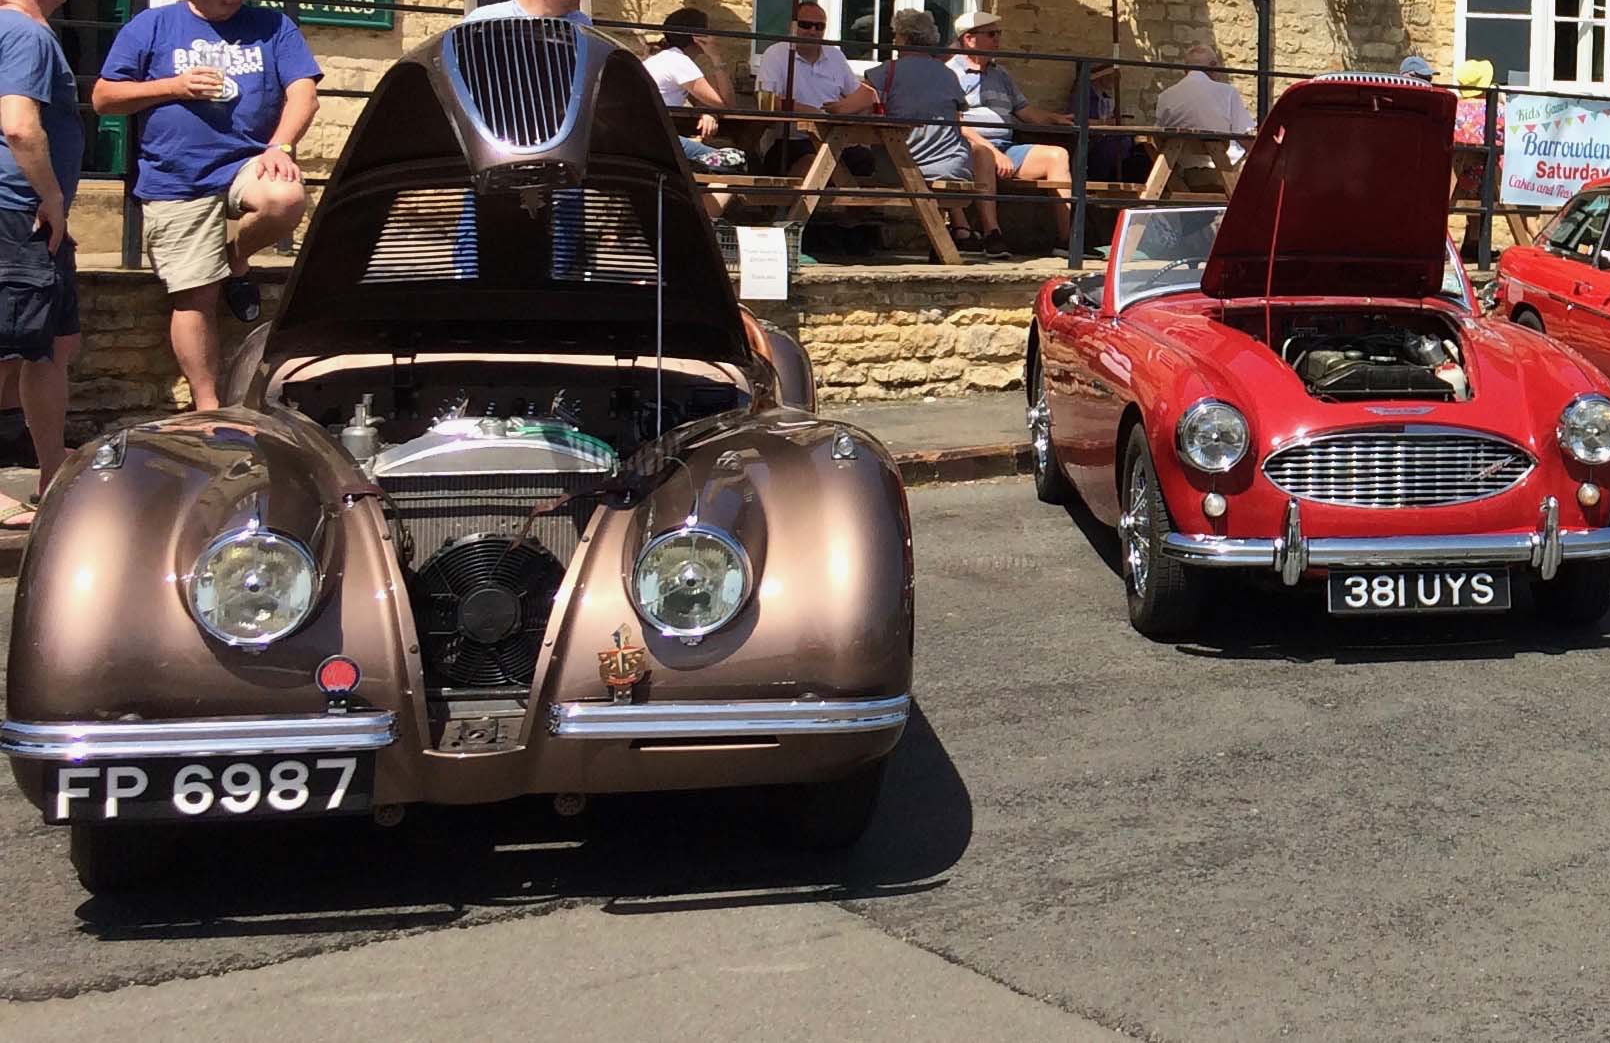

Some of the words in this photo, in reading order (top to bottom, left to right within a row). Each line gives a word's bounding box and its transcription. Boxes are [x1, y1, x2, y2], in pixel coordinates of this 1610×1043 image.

[1522, 132, 1610, 159] Barrowden
[1536, 160, 1609, 181] Saturday
[1509, 174, 1535, 193] Cakes
[1536, 182, 1553, 196] and
[1344, 574, 1405, 608] 381
[1417, 573, 1495, 606] UYS
[56, 766, 149, 820] FP
[172, 758, 357, 815] 6987
